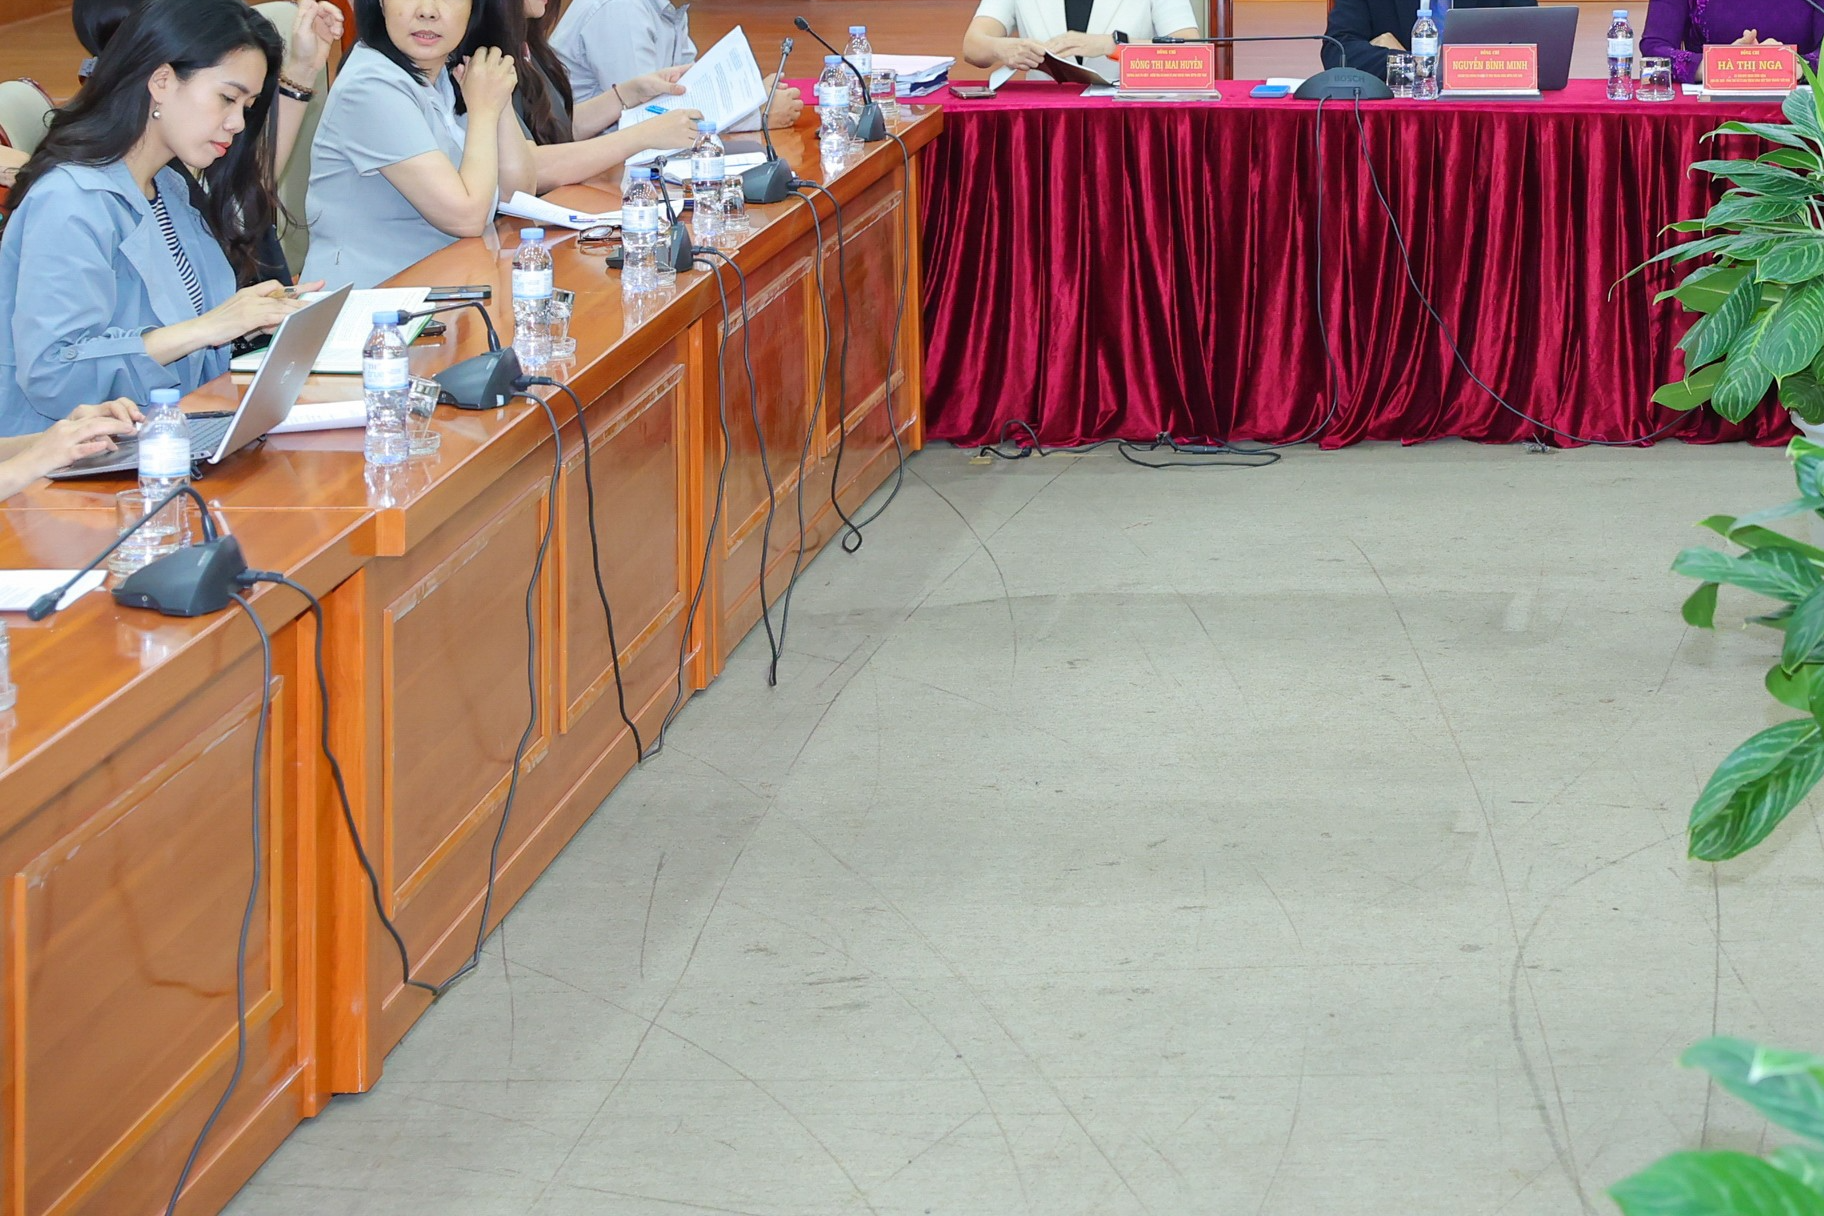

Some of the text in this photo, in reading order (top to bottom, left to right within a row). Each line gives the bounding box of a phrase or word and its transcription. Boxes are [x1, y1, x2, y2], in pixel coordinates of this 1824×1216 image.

[1151, 59, 1164, 72] THỊ
[1164, 60, 1179, 70] MAI
[1452, 56, 1484, 70] NGUYỄN
[1506, 60, 1528, 70] MINH
[1717, 58, 1783, 72] HÀ THỊ NGA
[1334, 74, 1365, 83] BOSCH
